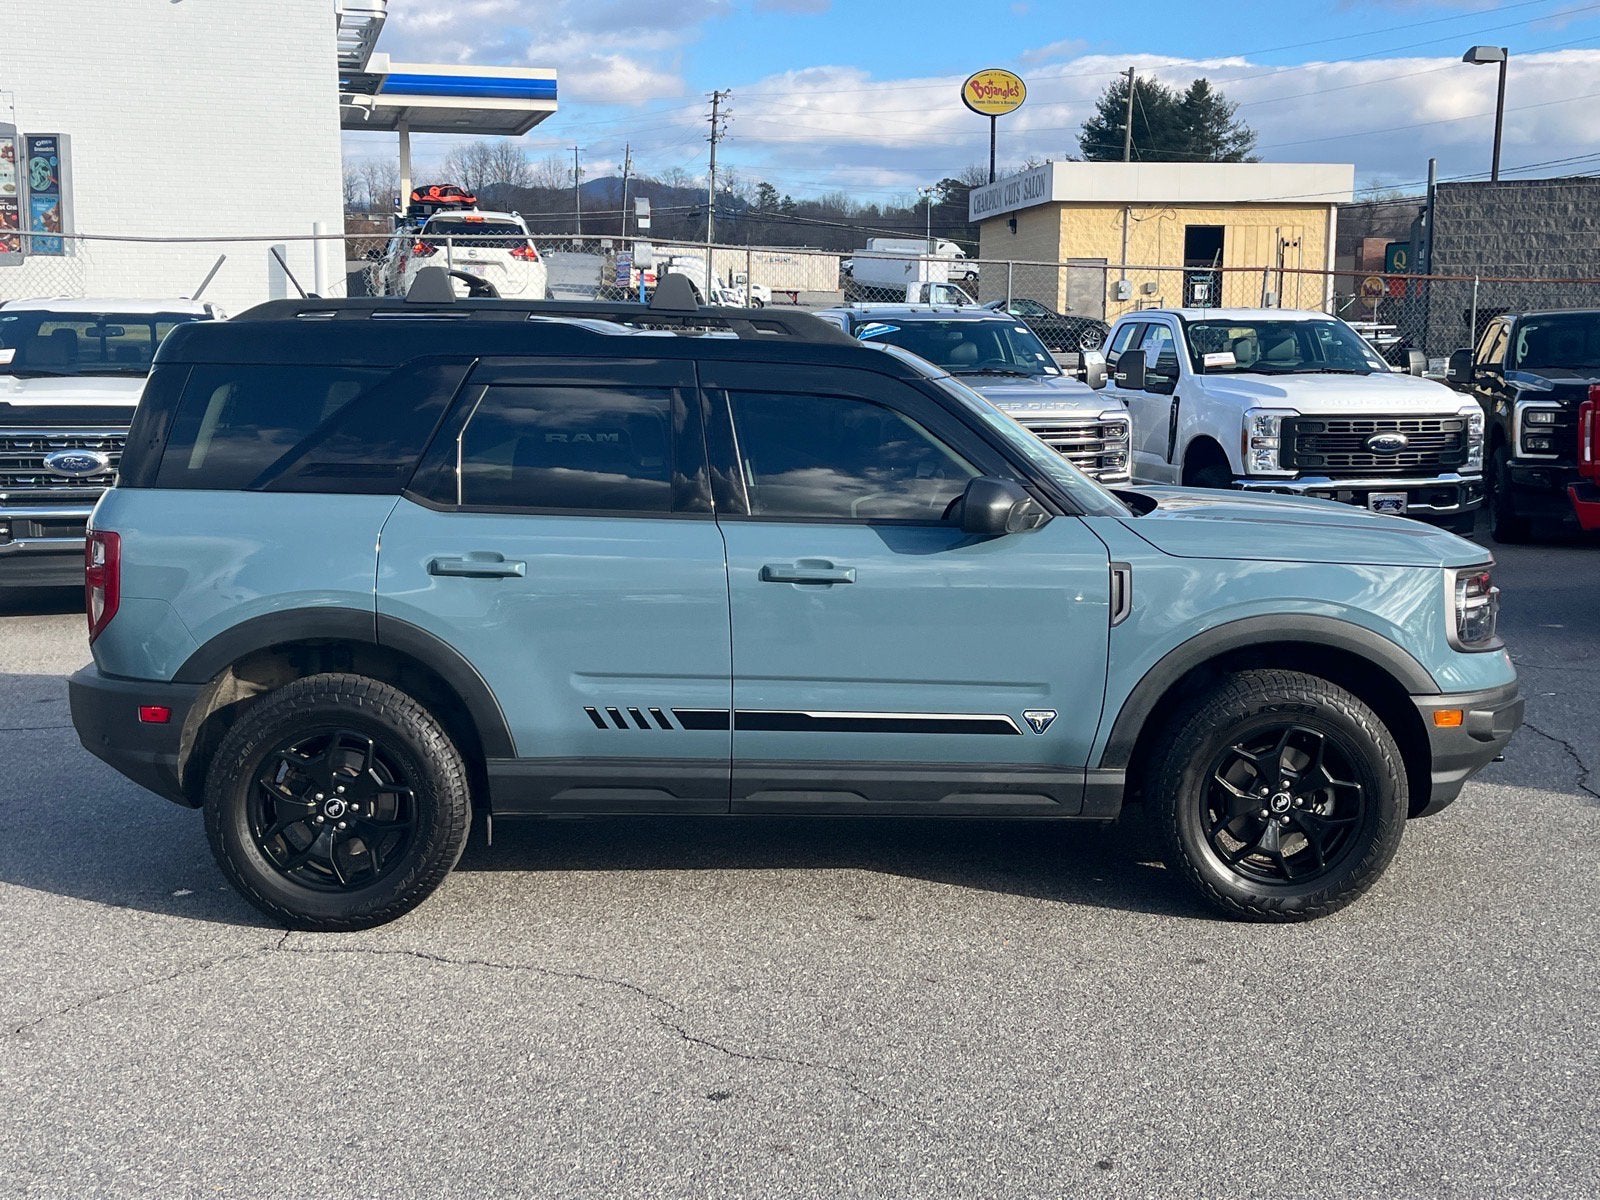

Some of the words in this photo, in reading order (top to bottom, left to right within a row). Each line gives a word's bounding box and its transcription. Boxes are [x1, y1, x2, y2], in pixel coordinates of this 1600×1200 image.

[973, 186, 1002, 216] CHAMPION
[1004, 180, 1021, 207] CUTS
[1023, 172, 1046, 201] SALON
[1393, 249, 1407, 270] Q
[544, 432, 619, 443] RAM
[60, 457, 91, 469] Ford
